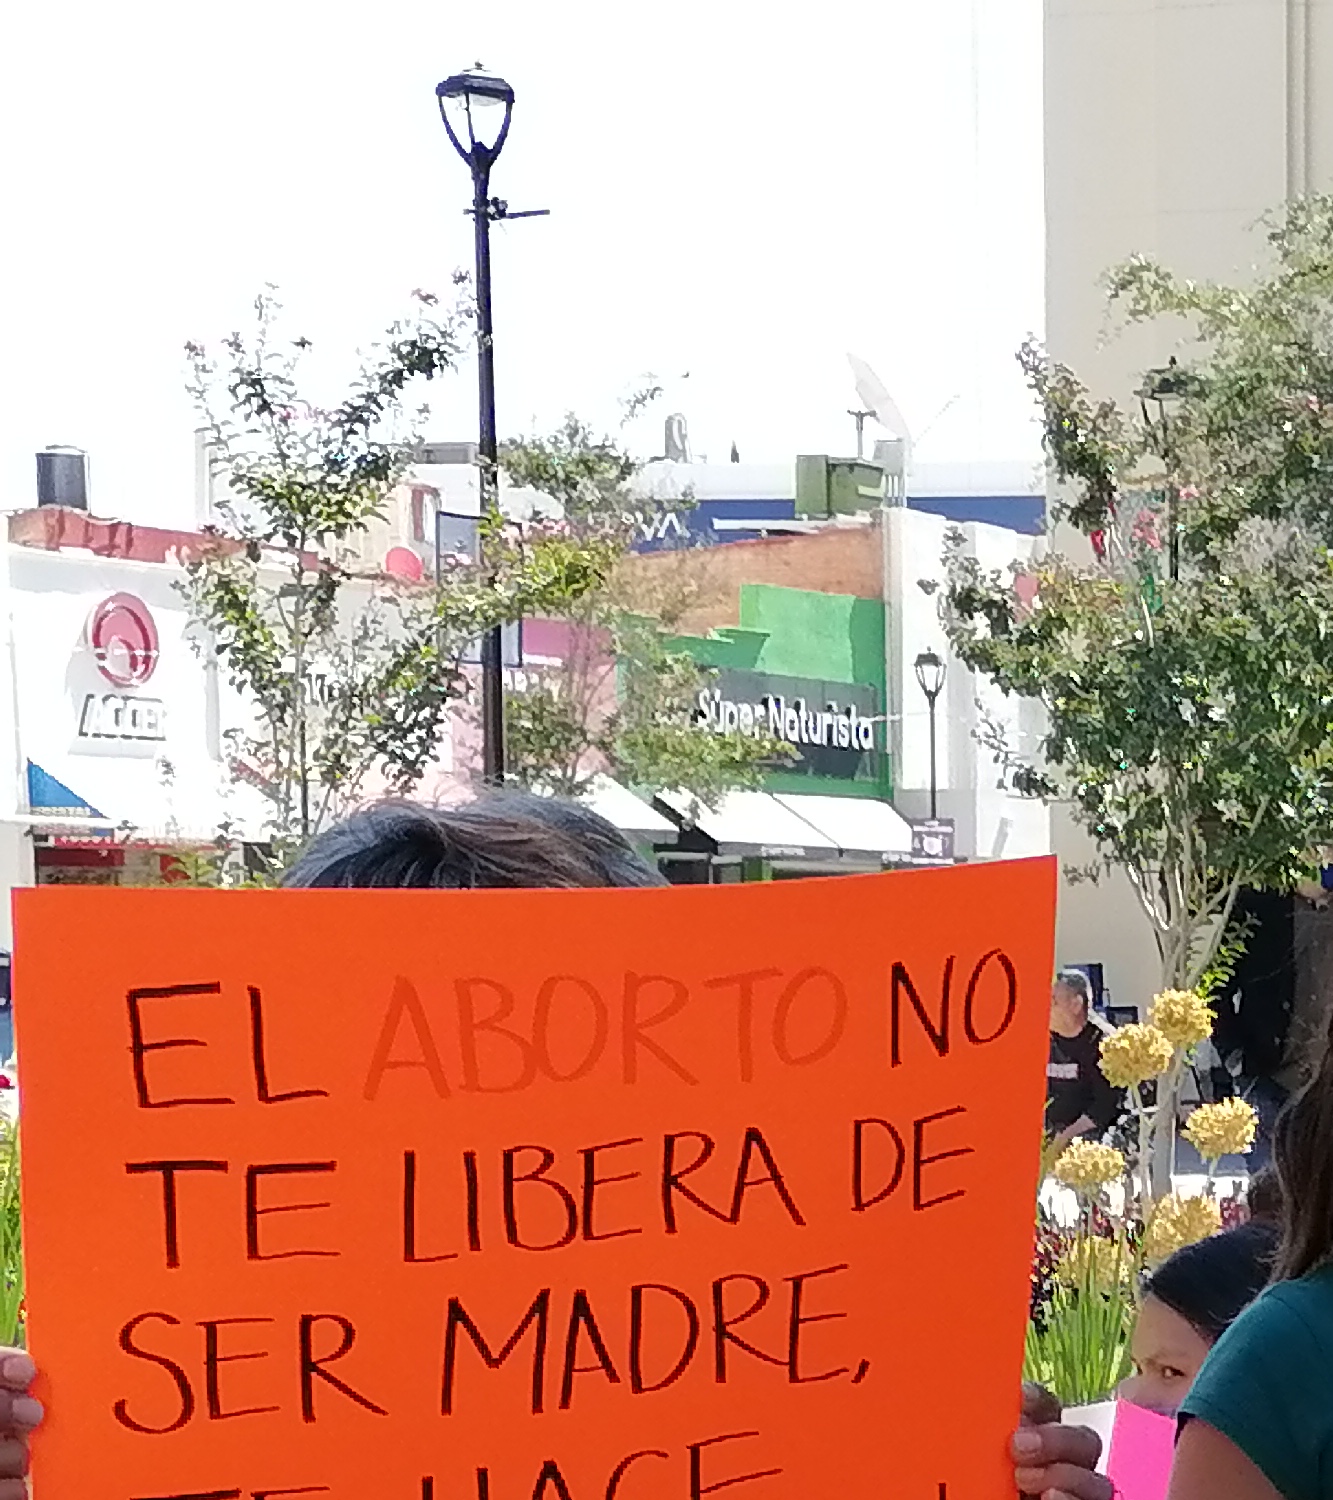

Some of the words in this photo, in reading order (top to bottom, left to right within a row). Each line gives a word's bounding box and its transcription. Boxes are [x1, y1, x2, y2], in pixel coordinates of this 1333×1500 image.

[697, 688, 765, 741] Súper
[766, 692, 875, 751] Naturista
[126, 982, 330, 1108] EL
[362, 966, 848, 1101] ABORTO
[888, 948, 1019, 1067] NO
[126, 1159, 342, 1269] TE
[401, 1126, 807, 1264] LIBERA
[850, 1106, 975, 1213] DE
[113, 1312, 390, 1436] SER
[440, 1264, 871, 1415] MADRE,
